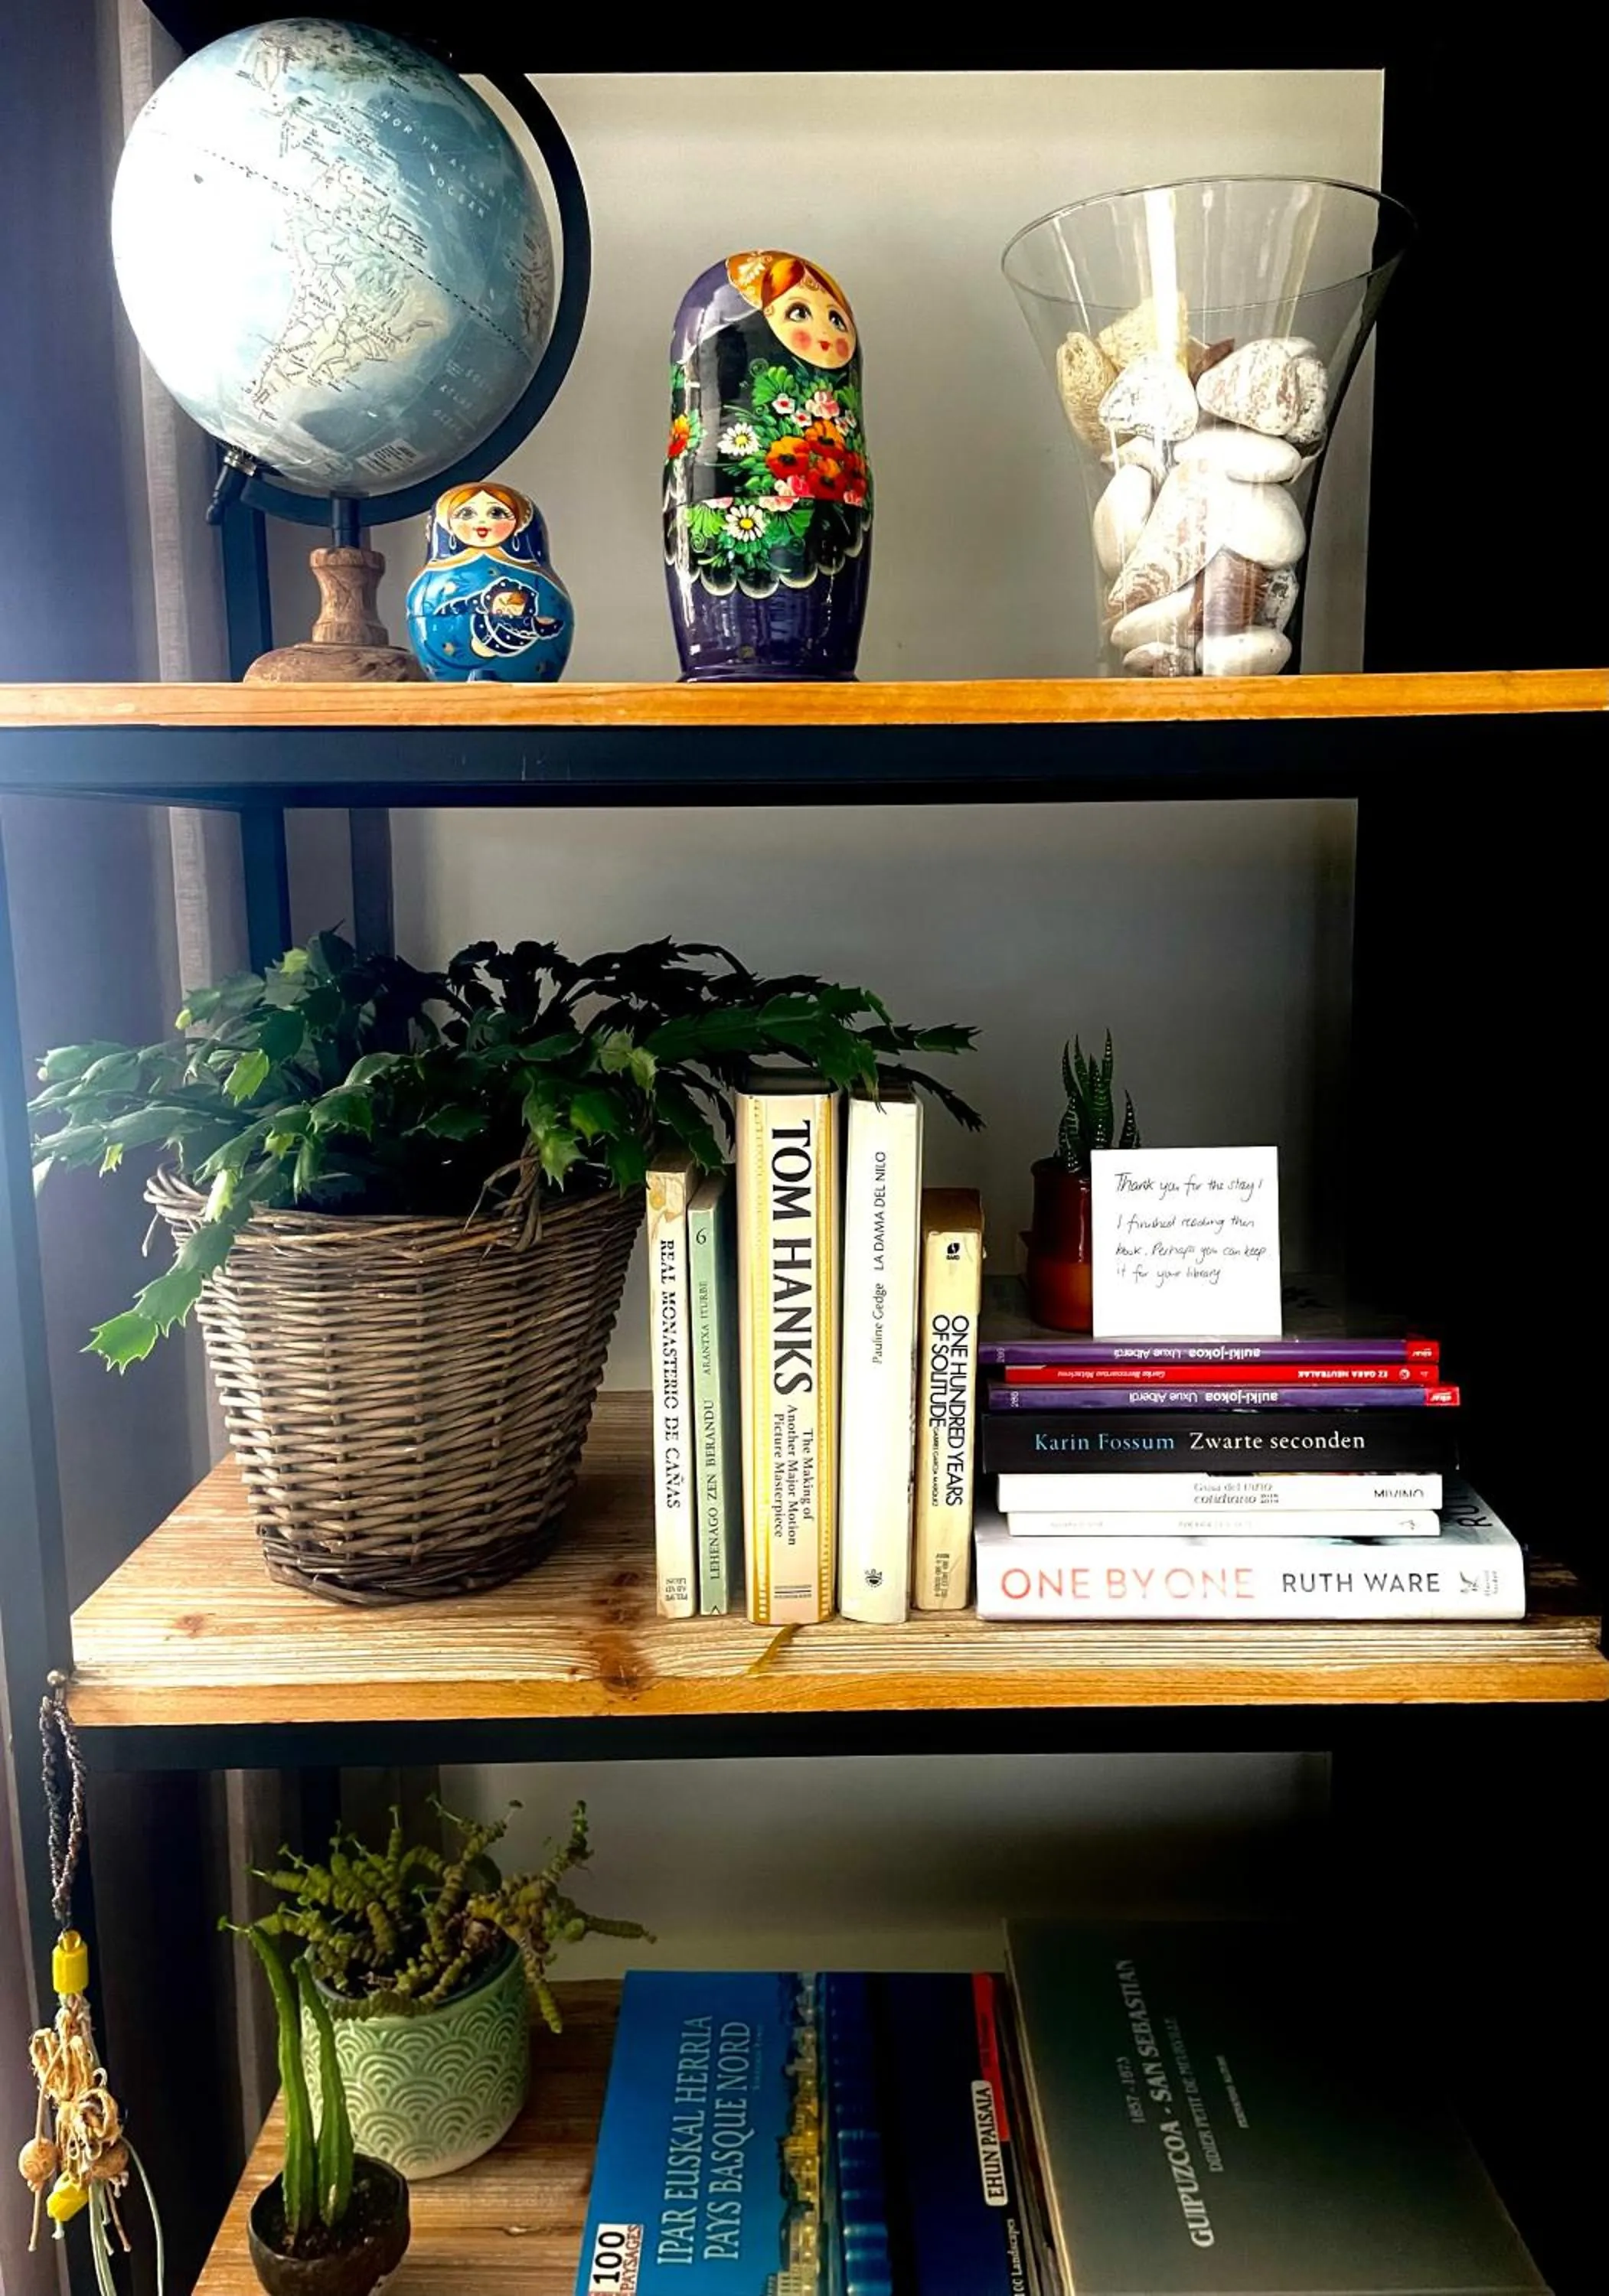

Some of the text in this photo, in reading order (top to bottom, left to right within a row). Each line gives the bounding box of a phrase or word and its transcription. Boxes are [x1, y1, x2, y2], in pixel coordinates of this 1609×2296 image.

[873, 1151, 886, 1270] LA DAMA DEL NILO
[1115, 1172, 1154, 1192] Thank
[1158, 1182, 1180, 1201] you
[1183, 1173, 1202, 1197] for
[1207, 1179, 1224, 1191] the
[696, 1228, 707, 1245] 6
[1117, 1214, 1123, 1229] I
[1126, 1213, 1177, 1234] finished
[1181, 1217, 1225, 1235] reading
[1152, 1241, 1195, 1260] Perhaps
[1196, 1246, 1218, 1264] you
[1222, 1246, 1240, 1256] can
[1244, 1244, 1267, 1262] keep
[772, 1120, 813, 1396] TOM HANKS
[1117, 1264, 1222, 1289] it for your library
[699, 1324, 711, 1375] ARANTXA
[872, 1283, 886, 1364] Pauline Gedge
[1114, 1347, 1261, 1360] aulki-jokoa Uxue Alberdi
[661, 1240, 684, 1508] REAL MONASTERIO DE CAÑAS
[929, 1315, 950, 1427] OF SOLITUDE
[1129, 1390, 1278, 1404] aulki-jokoa Uxue Alberdi
[945, 1315, 969, 1506] ONE HUNDRED YEARS
[1035, 1431, 1366, 1451] Karin Fossum Zwarte seconden
[703, 1399, 720, 1580] LEHENAGO ZEN BERANDU
[772, 1414, 785, 1538] Picture Masterpiece
[785, 1404, 799, 1546] Another Major Motion
[800, 1427, 814, 1521] The Making of
[1001, 1567, 1441, 1601] ONE BY ONE RUTH WARE
[1115, 1959, 1160, 2058] SEBASTIAN
[1141, 2063, 1173, 2102] SAN
[658, 2015, 713, 2265] IPAR EUSKAL HERRIA
[703, 2020, 755, 2261] PAYS BASQUE NORD
[976, 2088, 998, 2147] PAISAIA
[984, 2151, 1004, 2199] EHUN
[1160, 2120, 1215, 2248] GUIPUZCOA
[592, 2231, 625, 2285] 100
[619, 2224, 641, 2291] PAYSAGES
